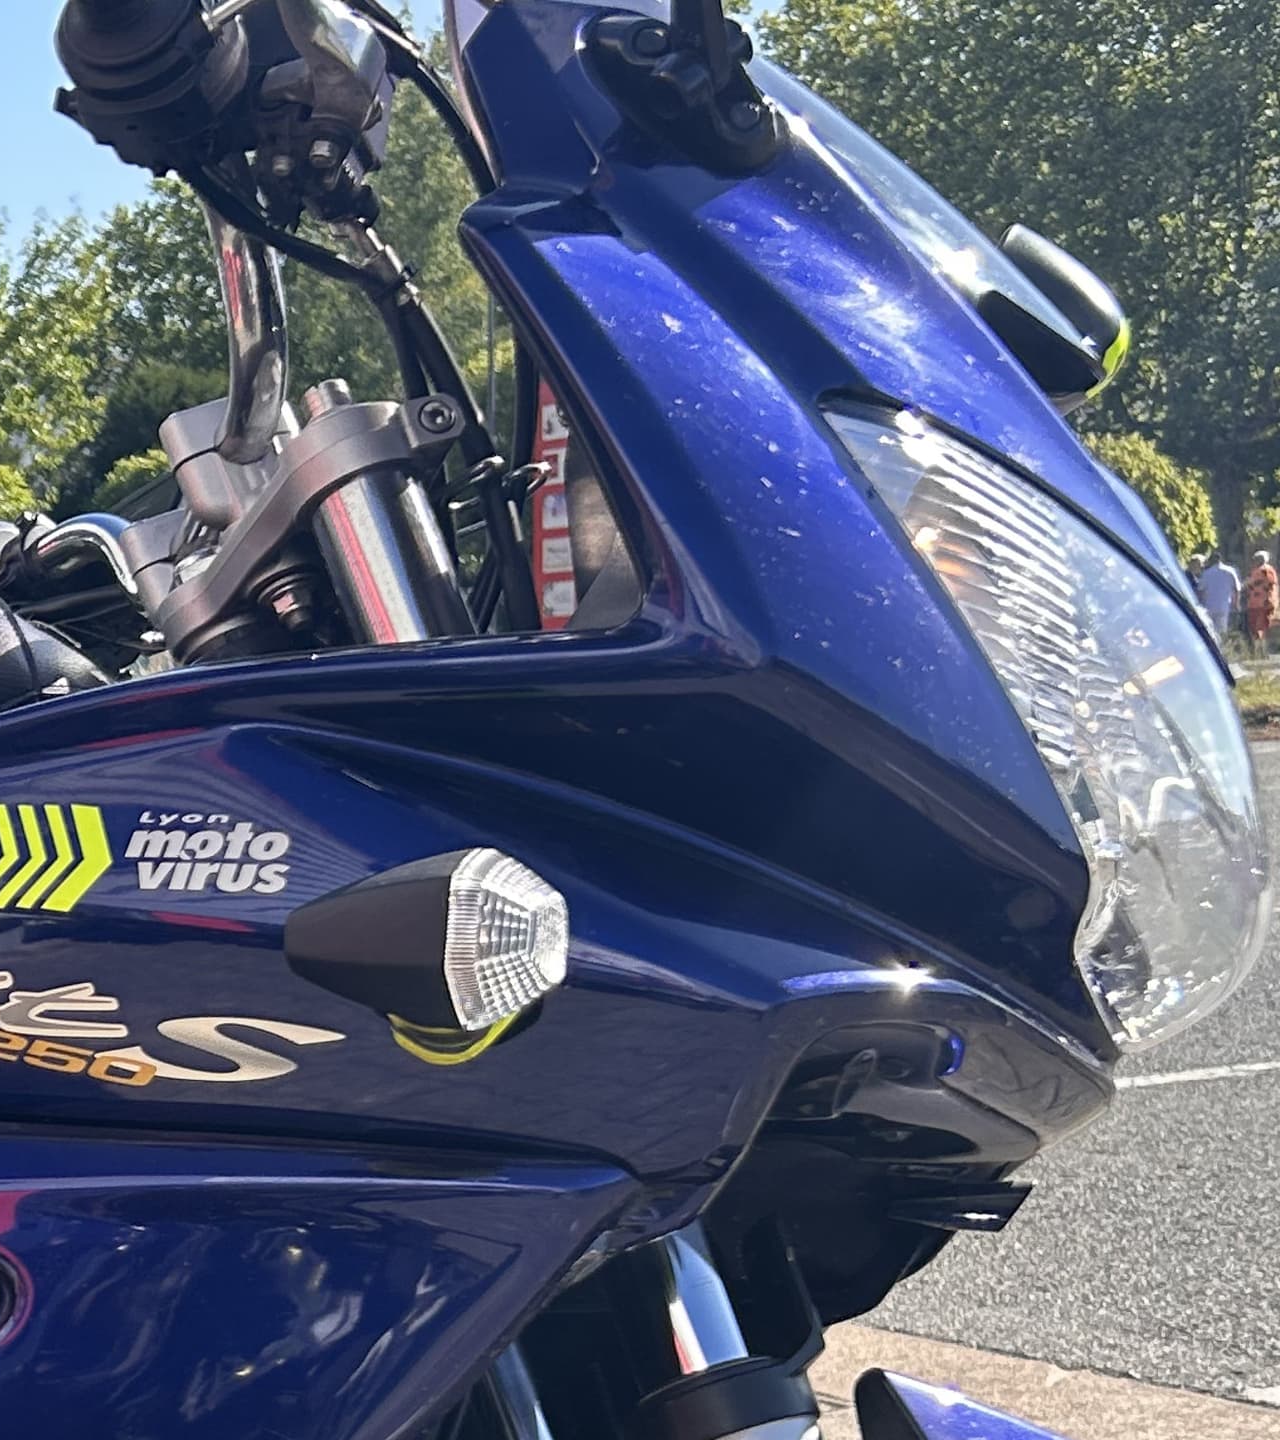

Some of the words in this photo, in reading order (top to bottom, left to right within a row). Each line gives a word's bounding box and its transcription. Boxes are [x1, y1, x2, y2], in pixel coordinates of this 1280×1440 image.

[139, 810, 229, 826] Lyon
[124, 822, 290, 861] moto
[137, 861, 291, 894] virus
[96, 1016, 346, 1082] S
